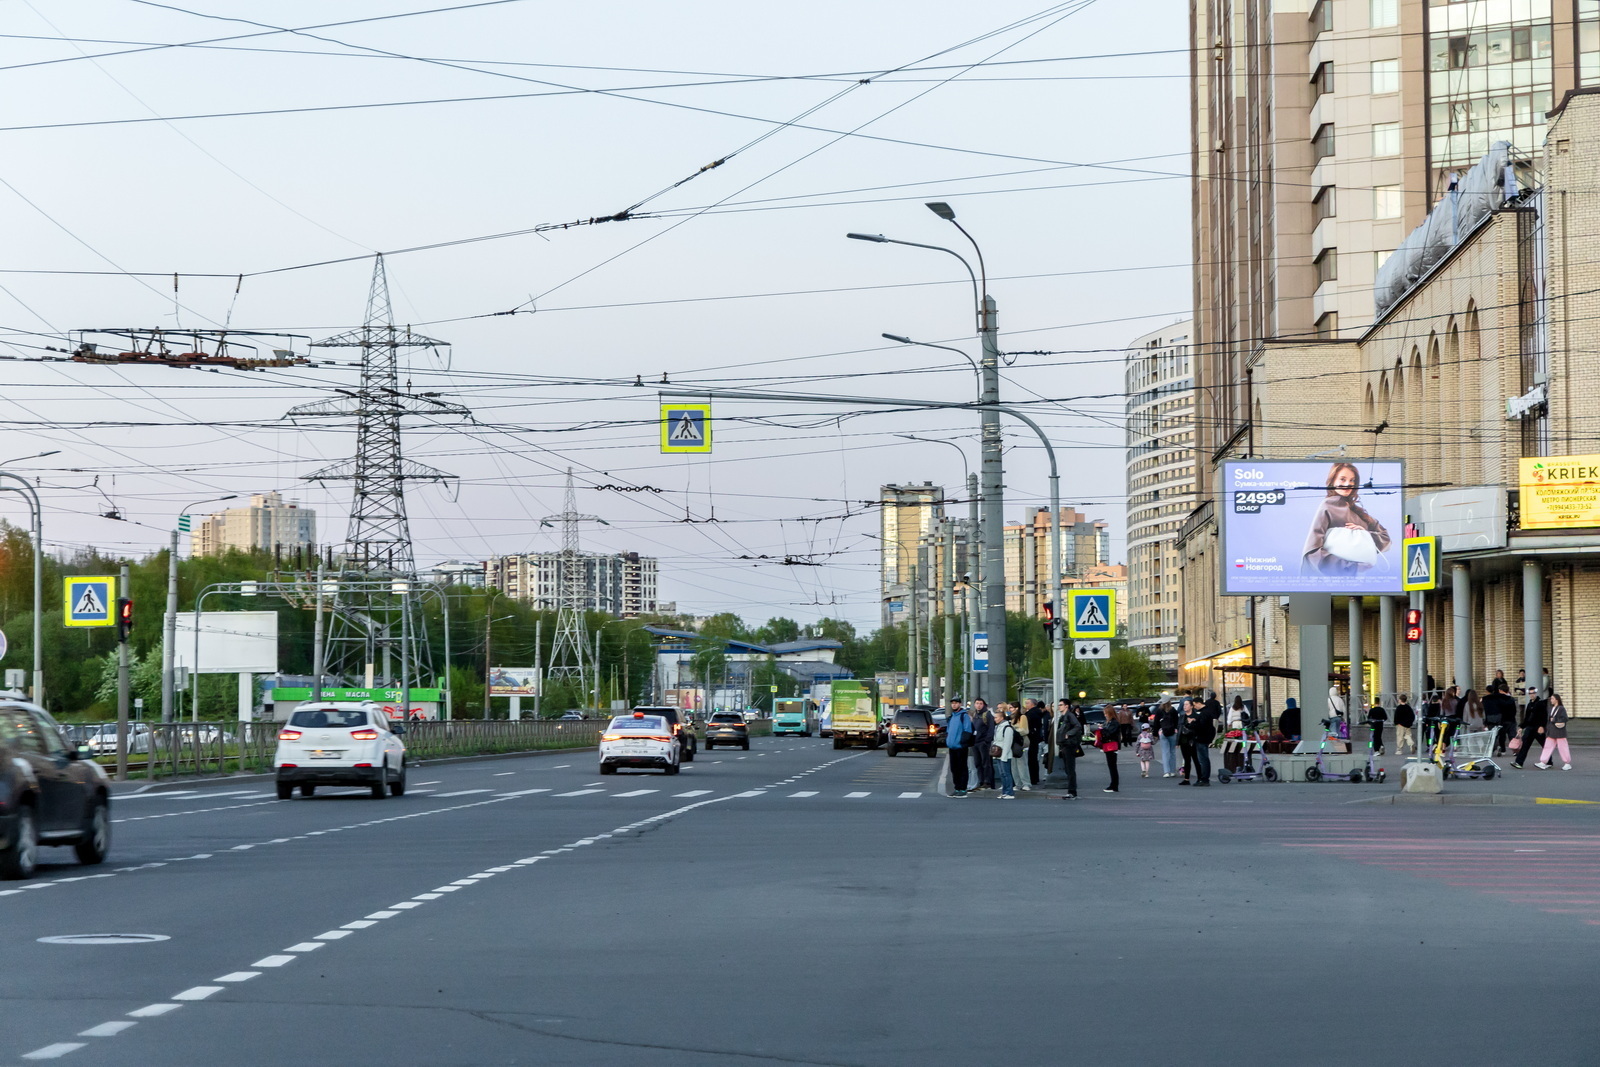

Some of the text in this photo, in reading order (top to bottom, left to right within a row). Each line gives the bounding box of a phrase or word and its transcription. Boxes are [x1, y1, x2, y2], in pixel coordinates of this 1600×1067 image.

[1234, 468, 1264, 480] Solo
[1547, 466, 1599, 480] KRIEK
[1234, 480, 1278, 488] Сумка-клатч
